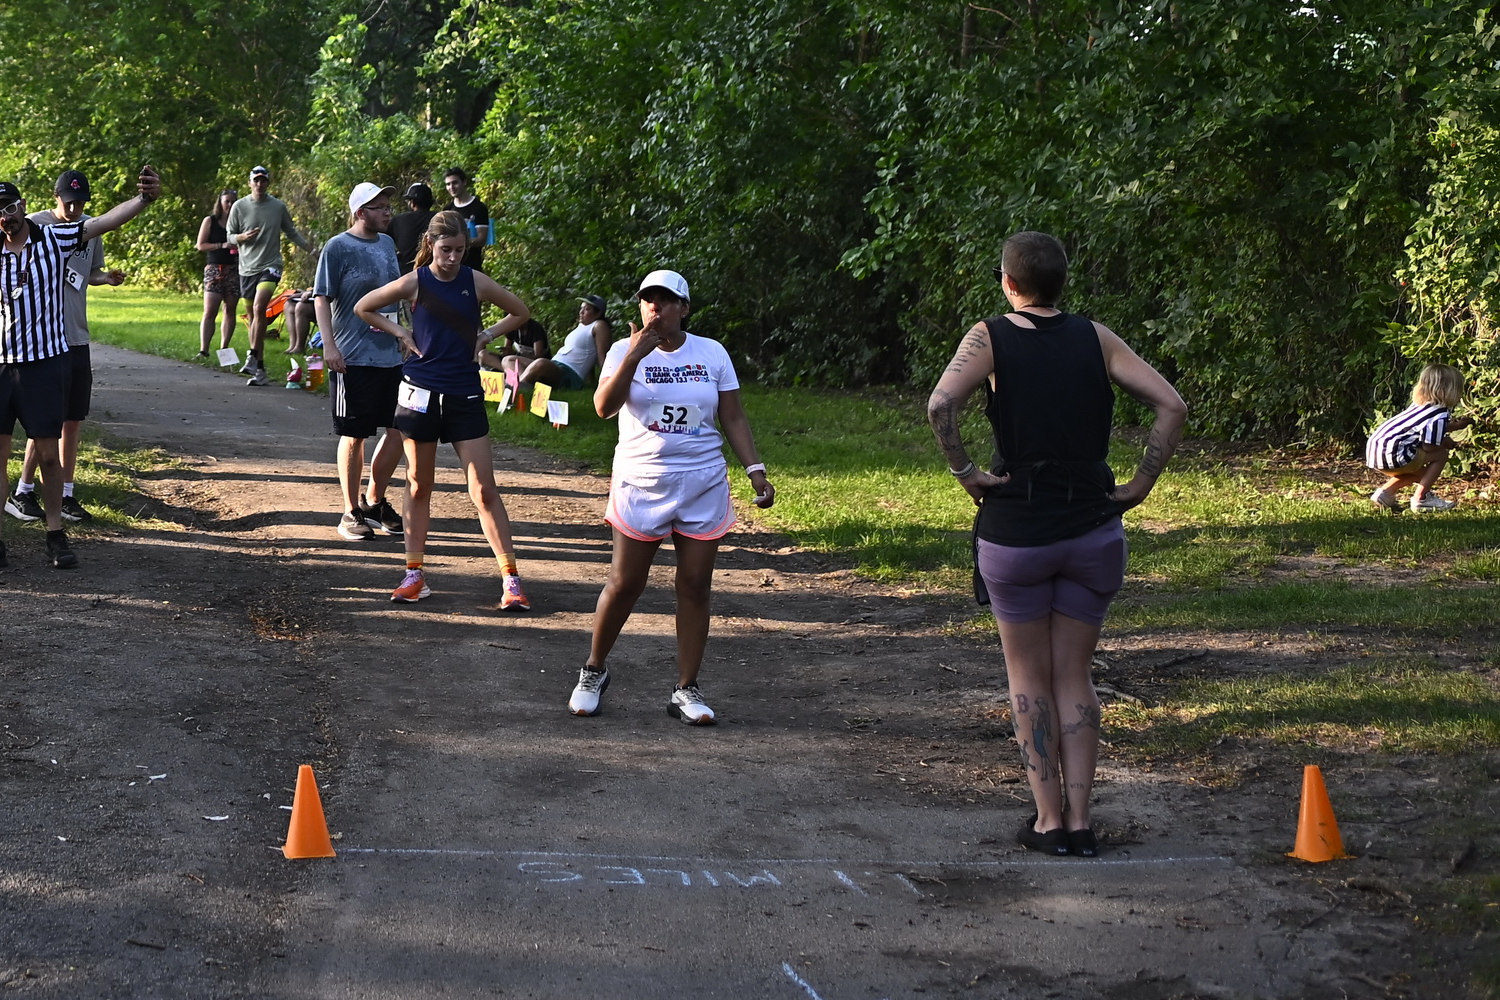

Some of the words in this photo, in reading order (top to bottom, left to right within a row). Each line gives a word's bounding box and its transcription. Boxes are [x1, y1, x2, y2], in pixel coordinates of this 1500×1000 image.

[407, 387, 415, 401] 7
[661, 405, 688, 425] 52
[518, 861, 782, 887] MILES
